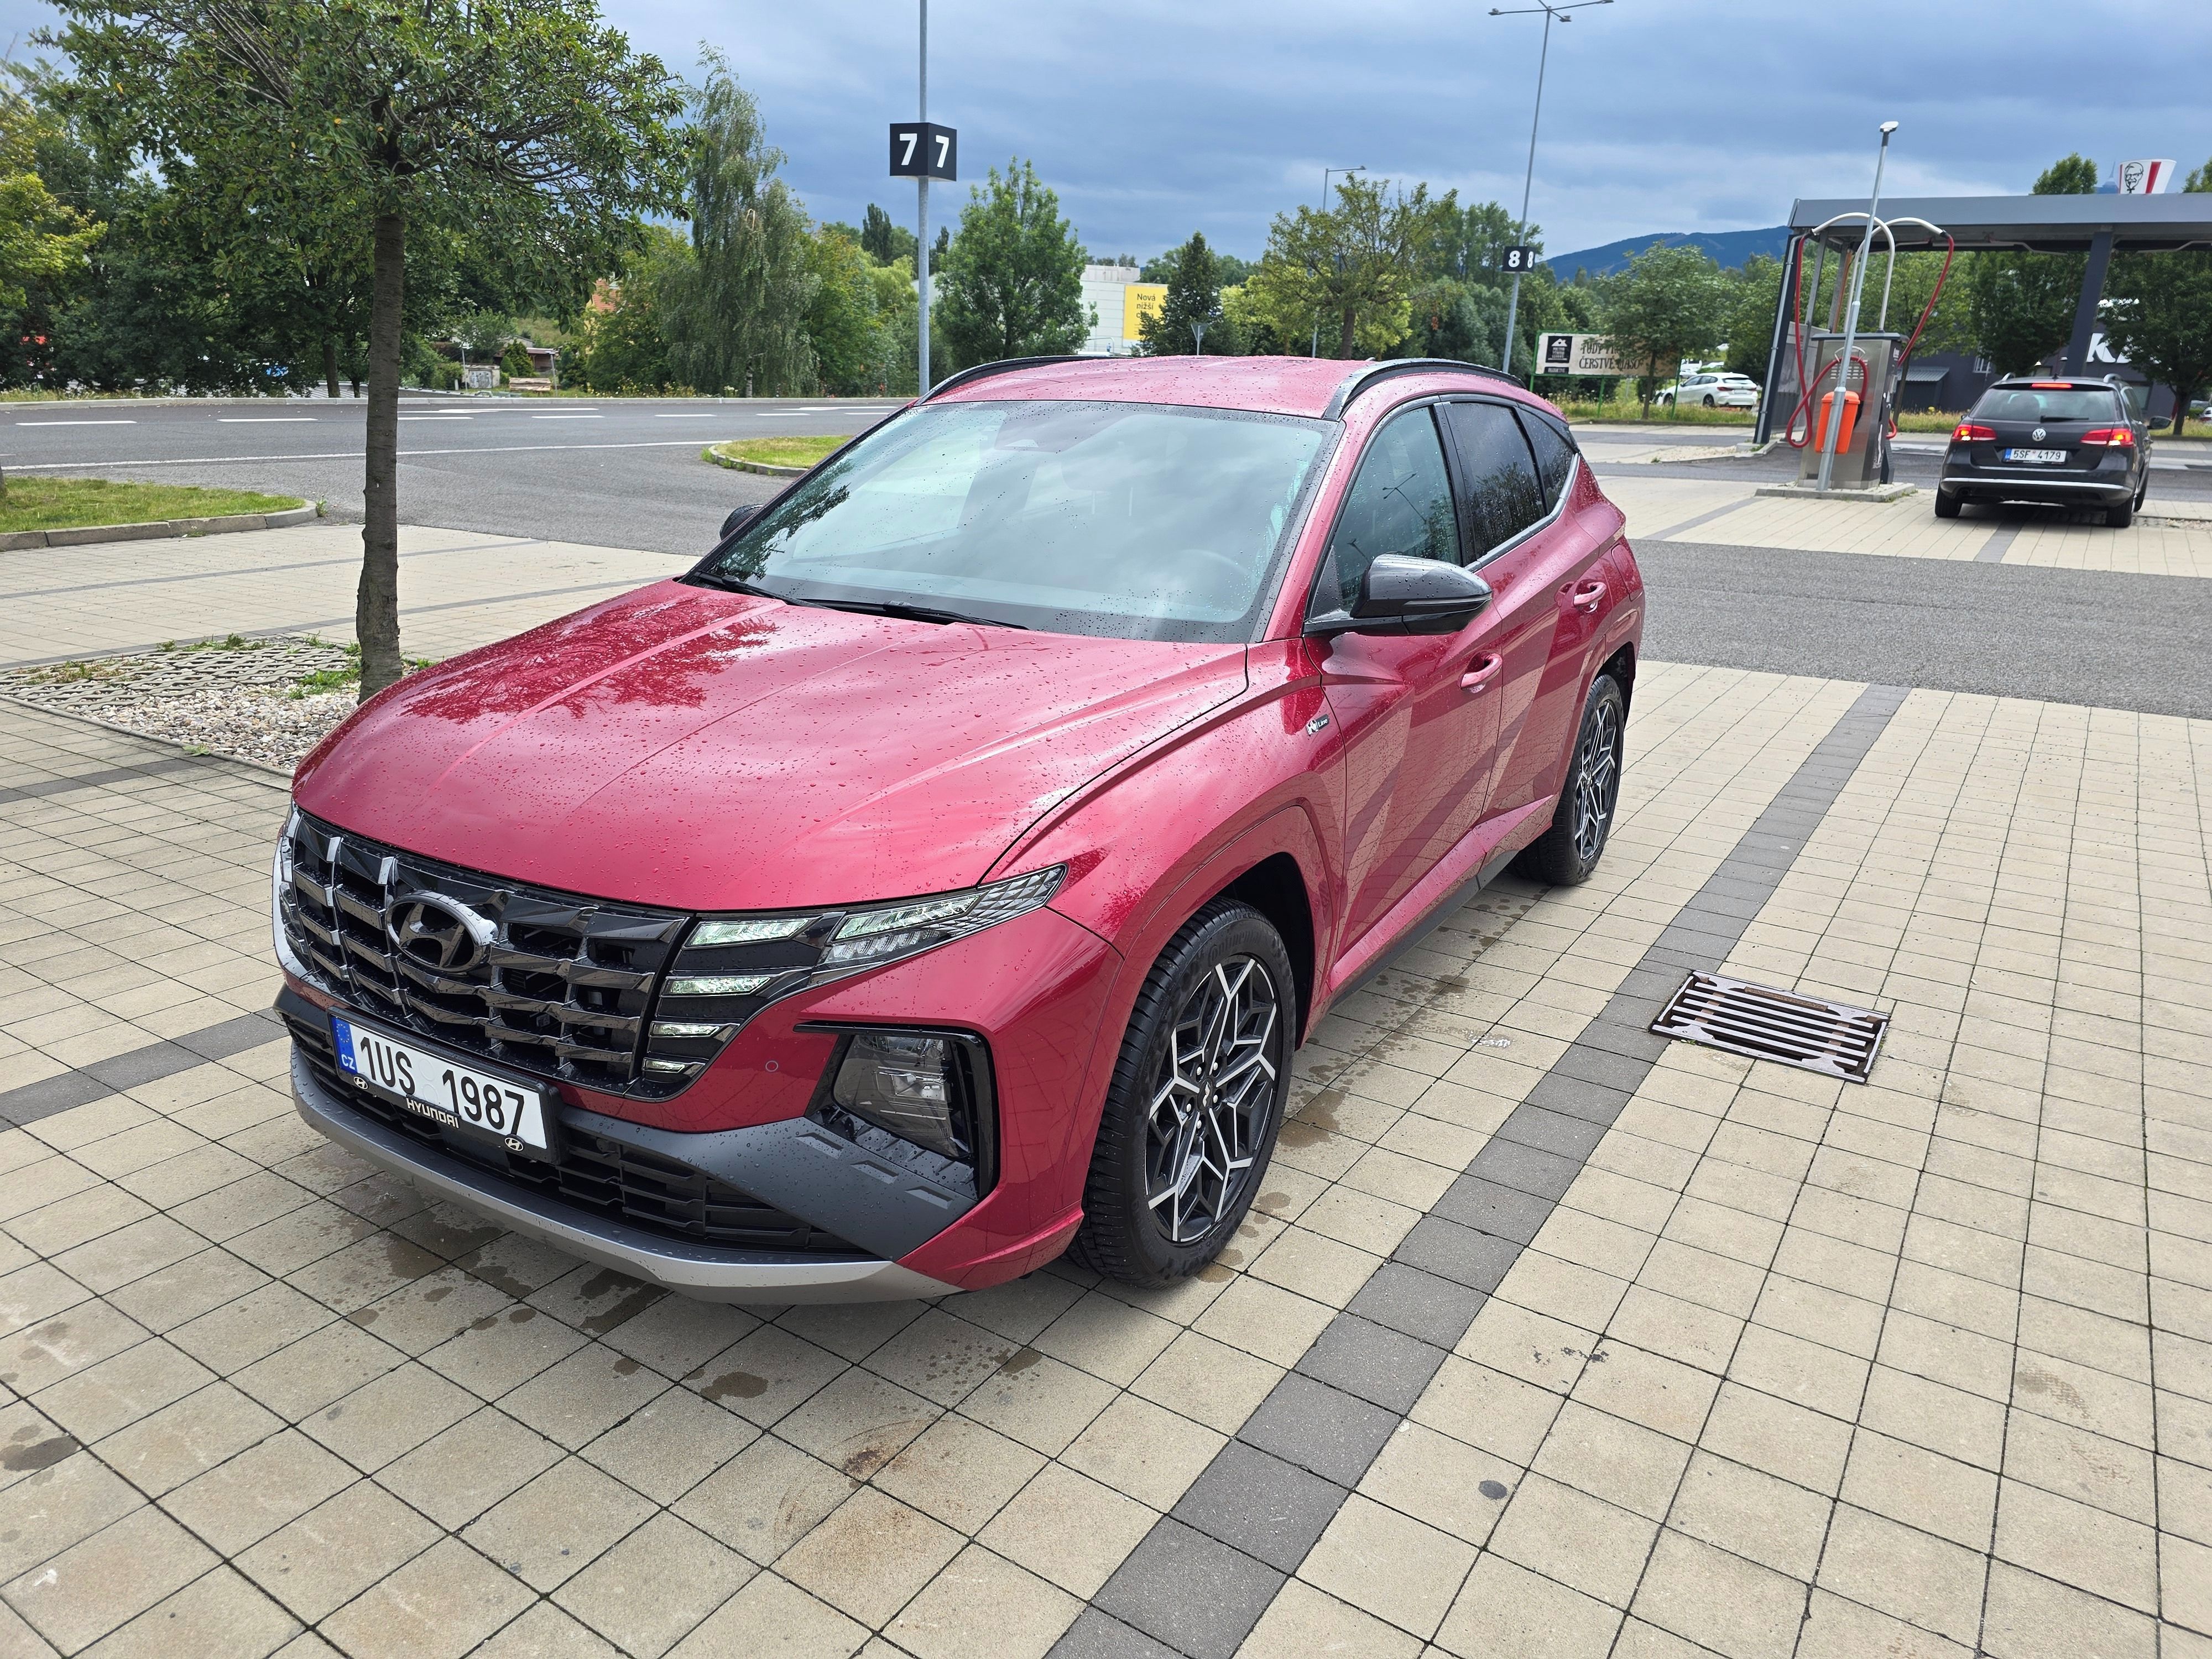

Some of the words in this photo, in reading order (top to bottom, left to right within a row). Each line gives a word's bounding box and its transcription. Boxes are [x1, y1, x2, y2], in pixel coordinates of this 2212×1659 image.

[900, 133, 917, 166] 7
[936, 134, 950, 168] 7
[1509, 250, 1521, 268] 8
[1527, 251, 1534, 268] 8
[1579, 355, 1615, 369] ČERSTVÉ
[2013, 450, 2031, 458] 5SF
[2037, 450, 2061, 460] 4179
[341, 1053, 356, 1071] CZ
[360, 1036, 416, 1095] 1US
[442, 1068, 525, 1136] 1987
[406, 1098, 460, 1129] HYUNDAI
